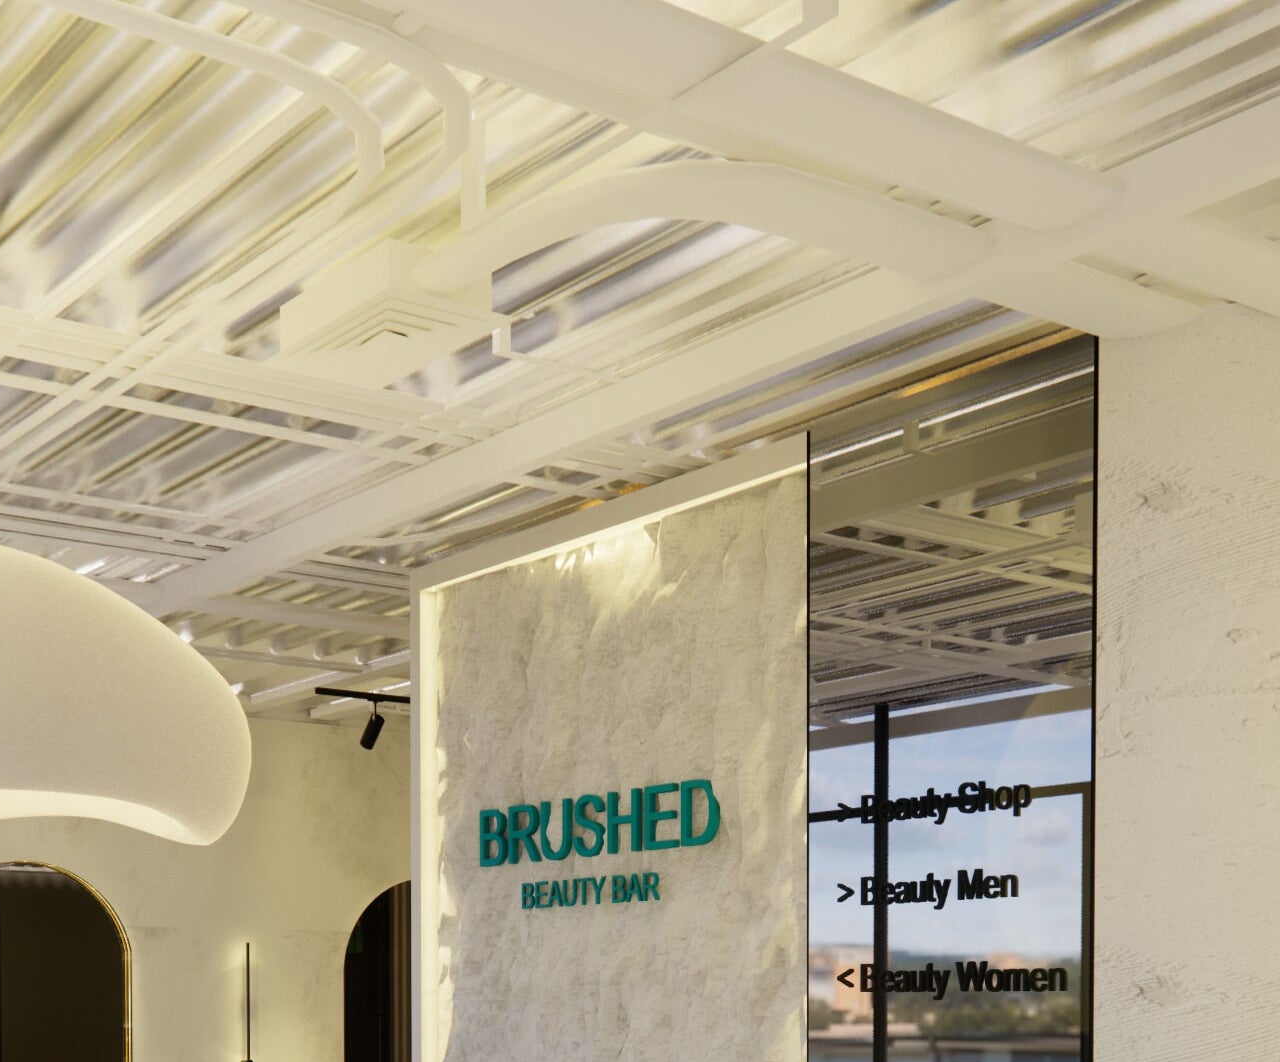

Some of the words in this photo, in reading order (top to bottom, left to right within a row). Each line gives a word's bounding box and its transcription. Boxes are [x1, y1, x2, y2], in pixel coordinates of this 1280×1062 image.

[479, 779, 721, 867] BRUSHED
[861, 787, 952, 825] Beauty
[957, 781, 1033, 817] Shop
[521, 876, 607, 909] BEAUTY
[611, 872, 661, 904] BAR
[861, 872, 951, 910] Beauty
[957, 869, 1019, 901] Men
[860, 963, 951, 1000] Beauty
[955, 961, 1068, 993] Women
